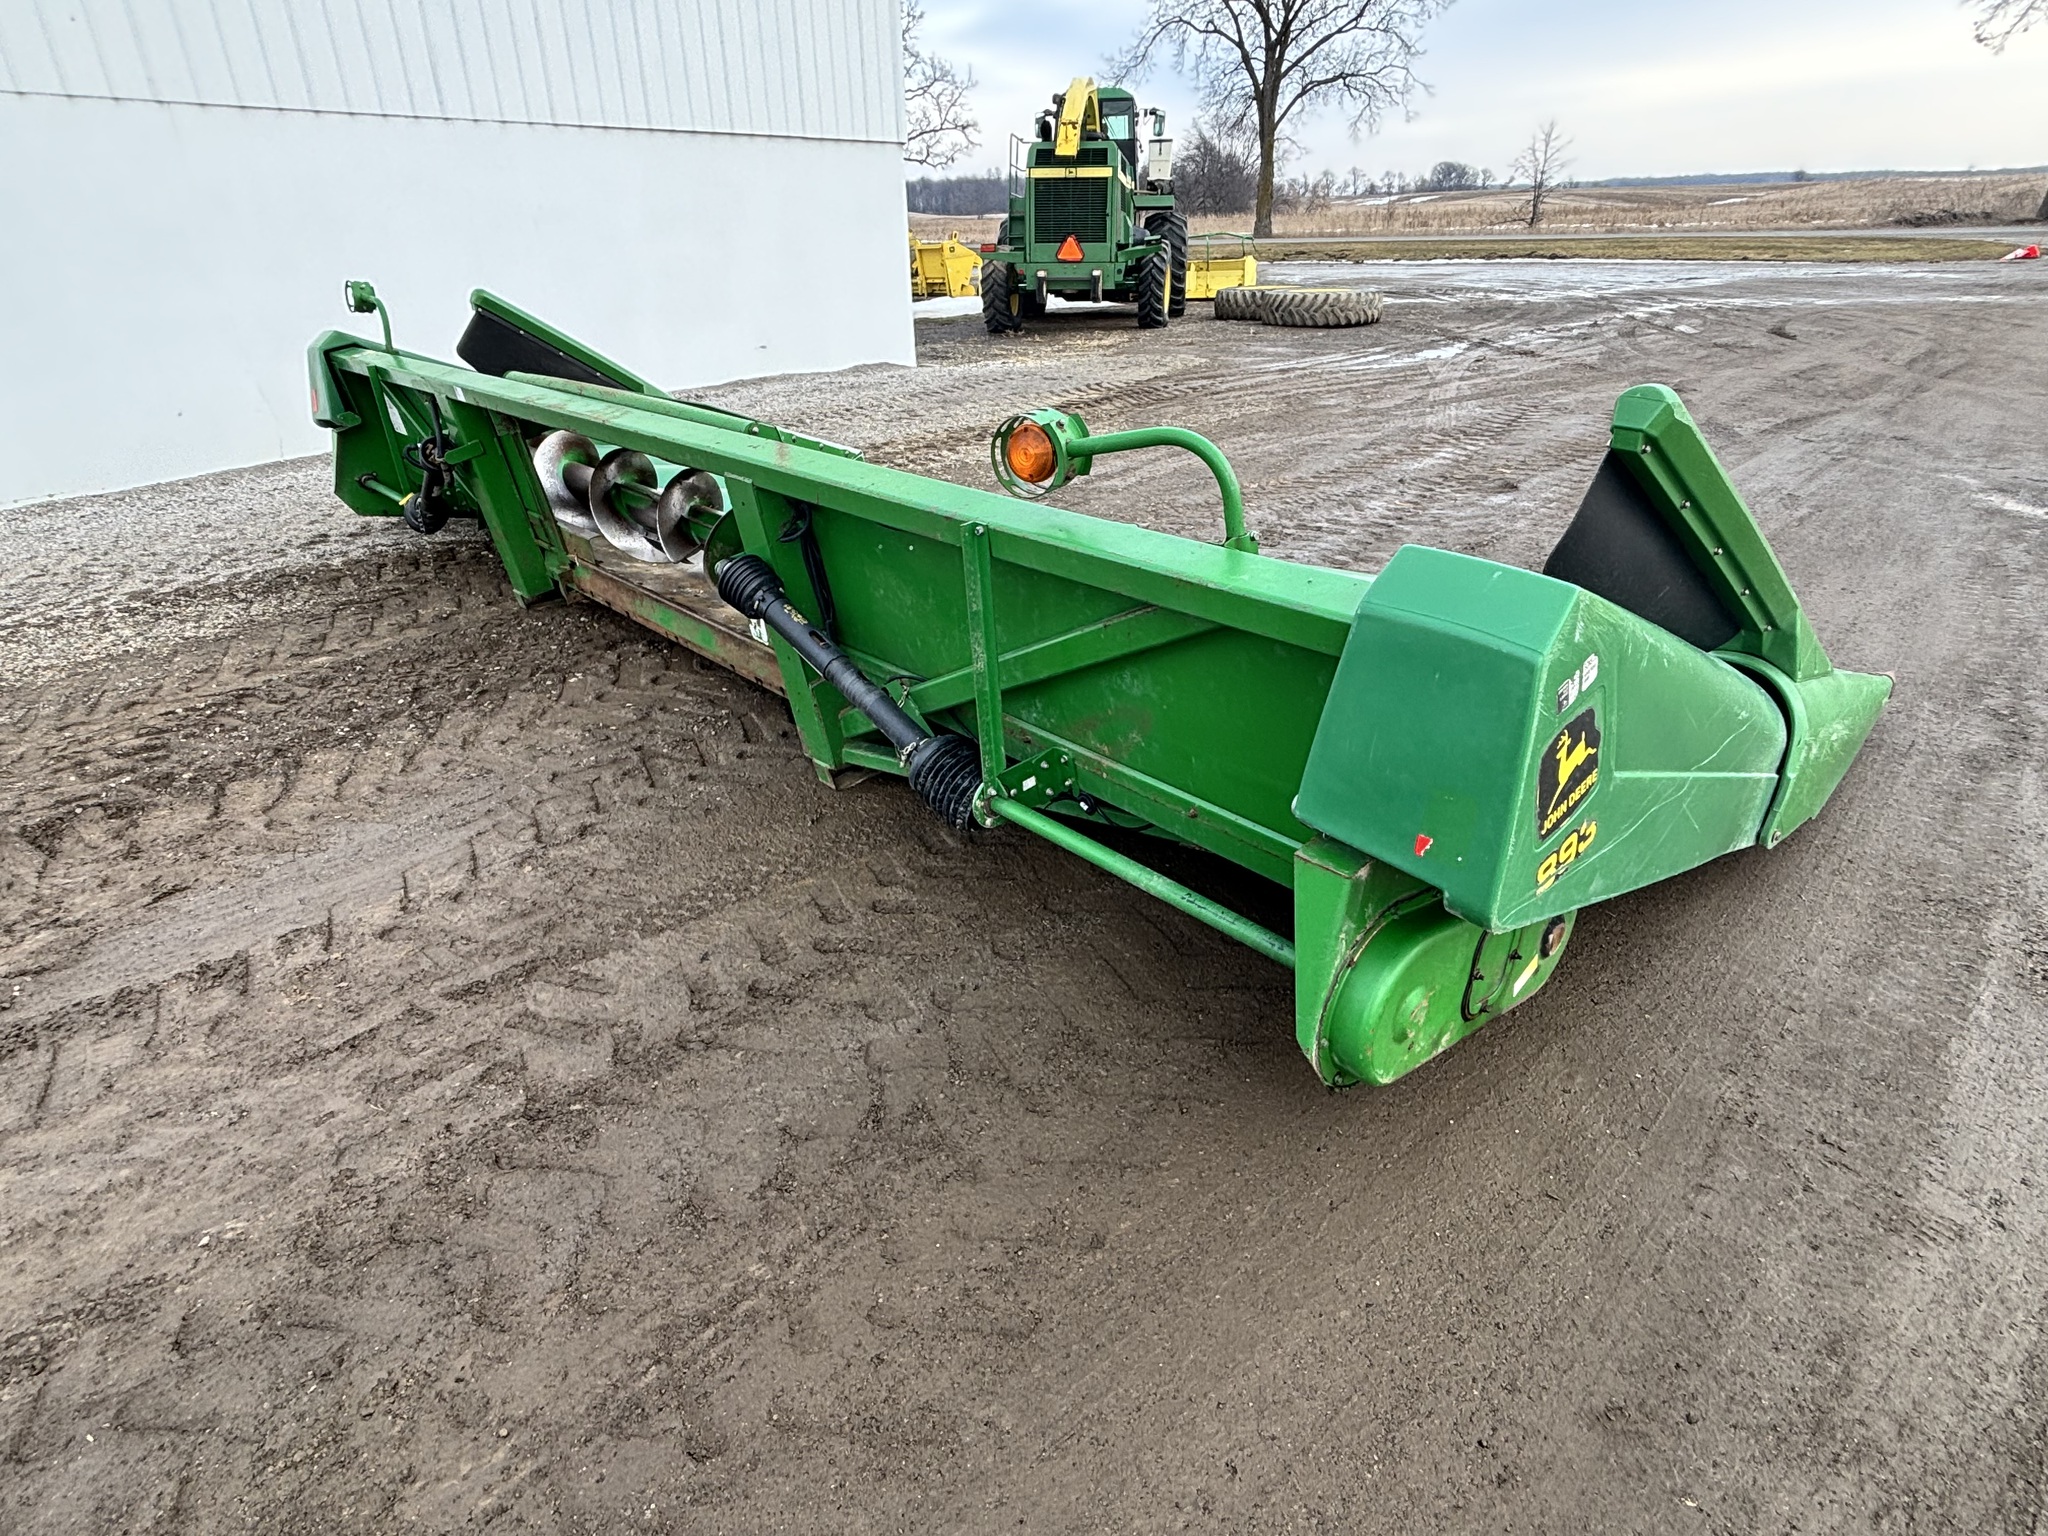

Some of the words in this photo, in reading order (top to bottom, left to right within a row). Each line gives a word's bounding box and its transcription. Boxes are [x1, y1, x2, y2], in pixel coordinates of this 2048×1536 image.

[1541, 800, 1567, 835] JOHN
[1569, 768, 1598, 807] DEERE
[1536, 819, 1597, 896] 893
